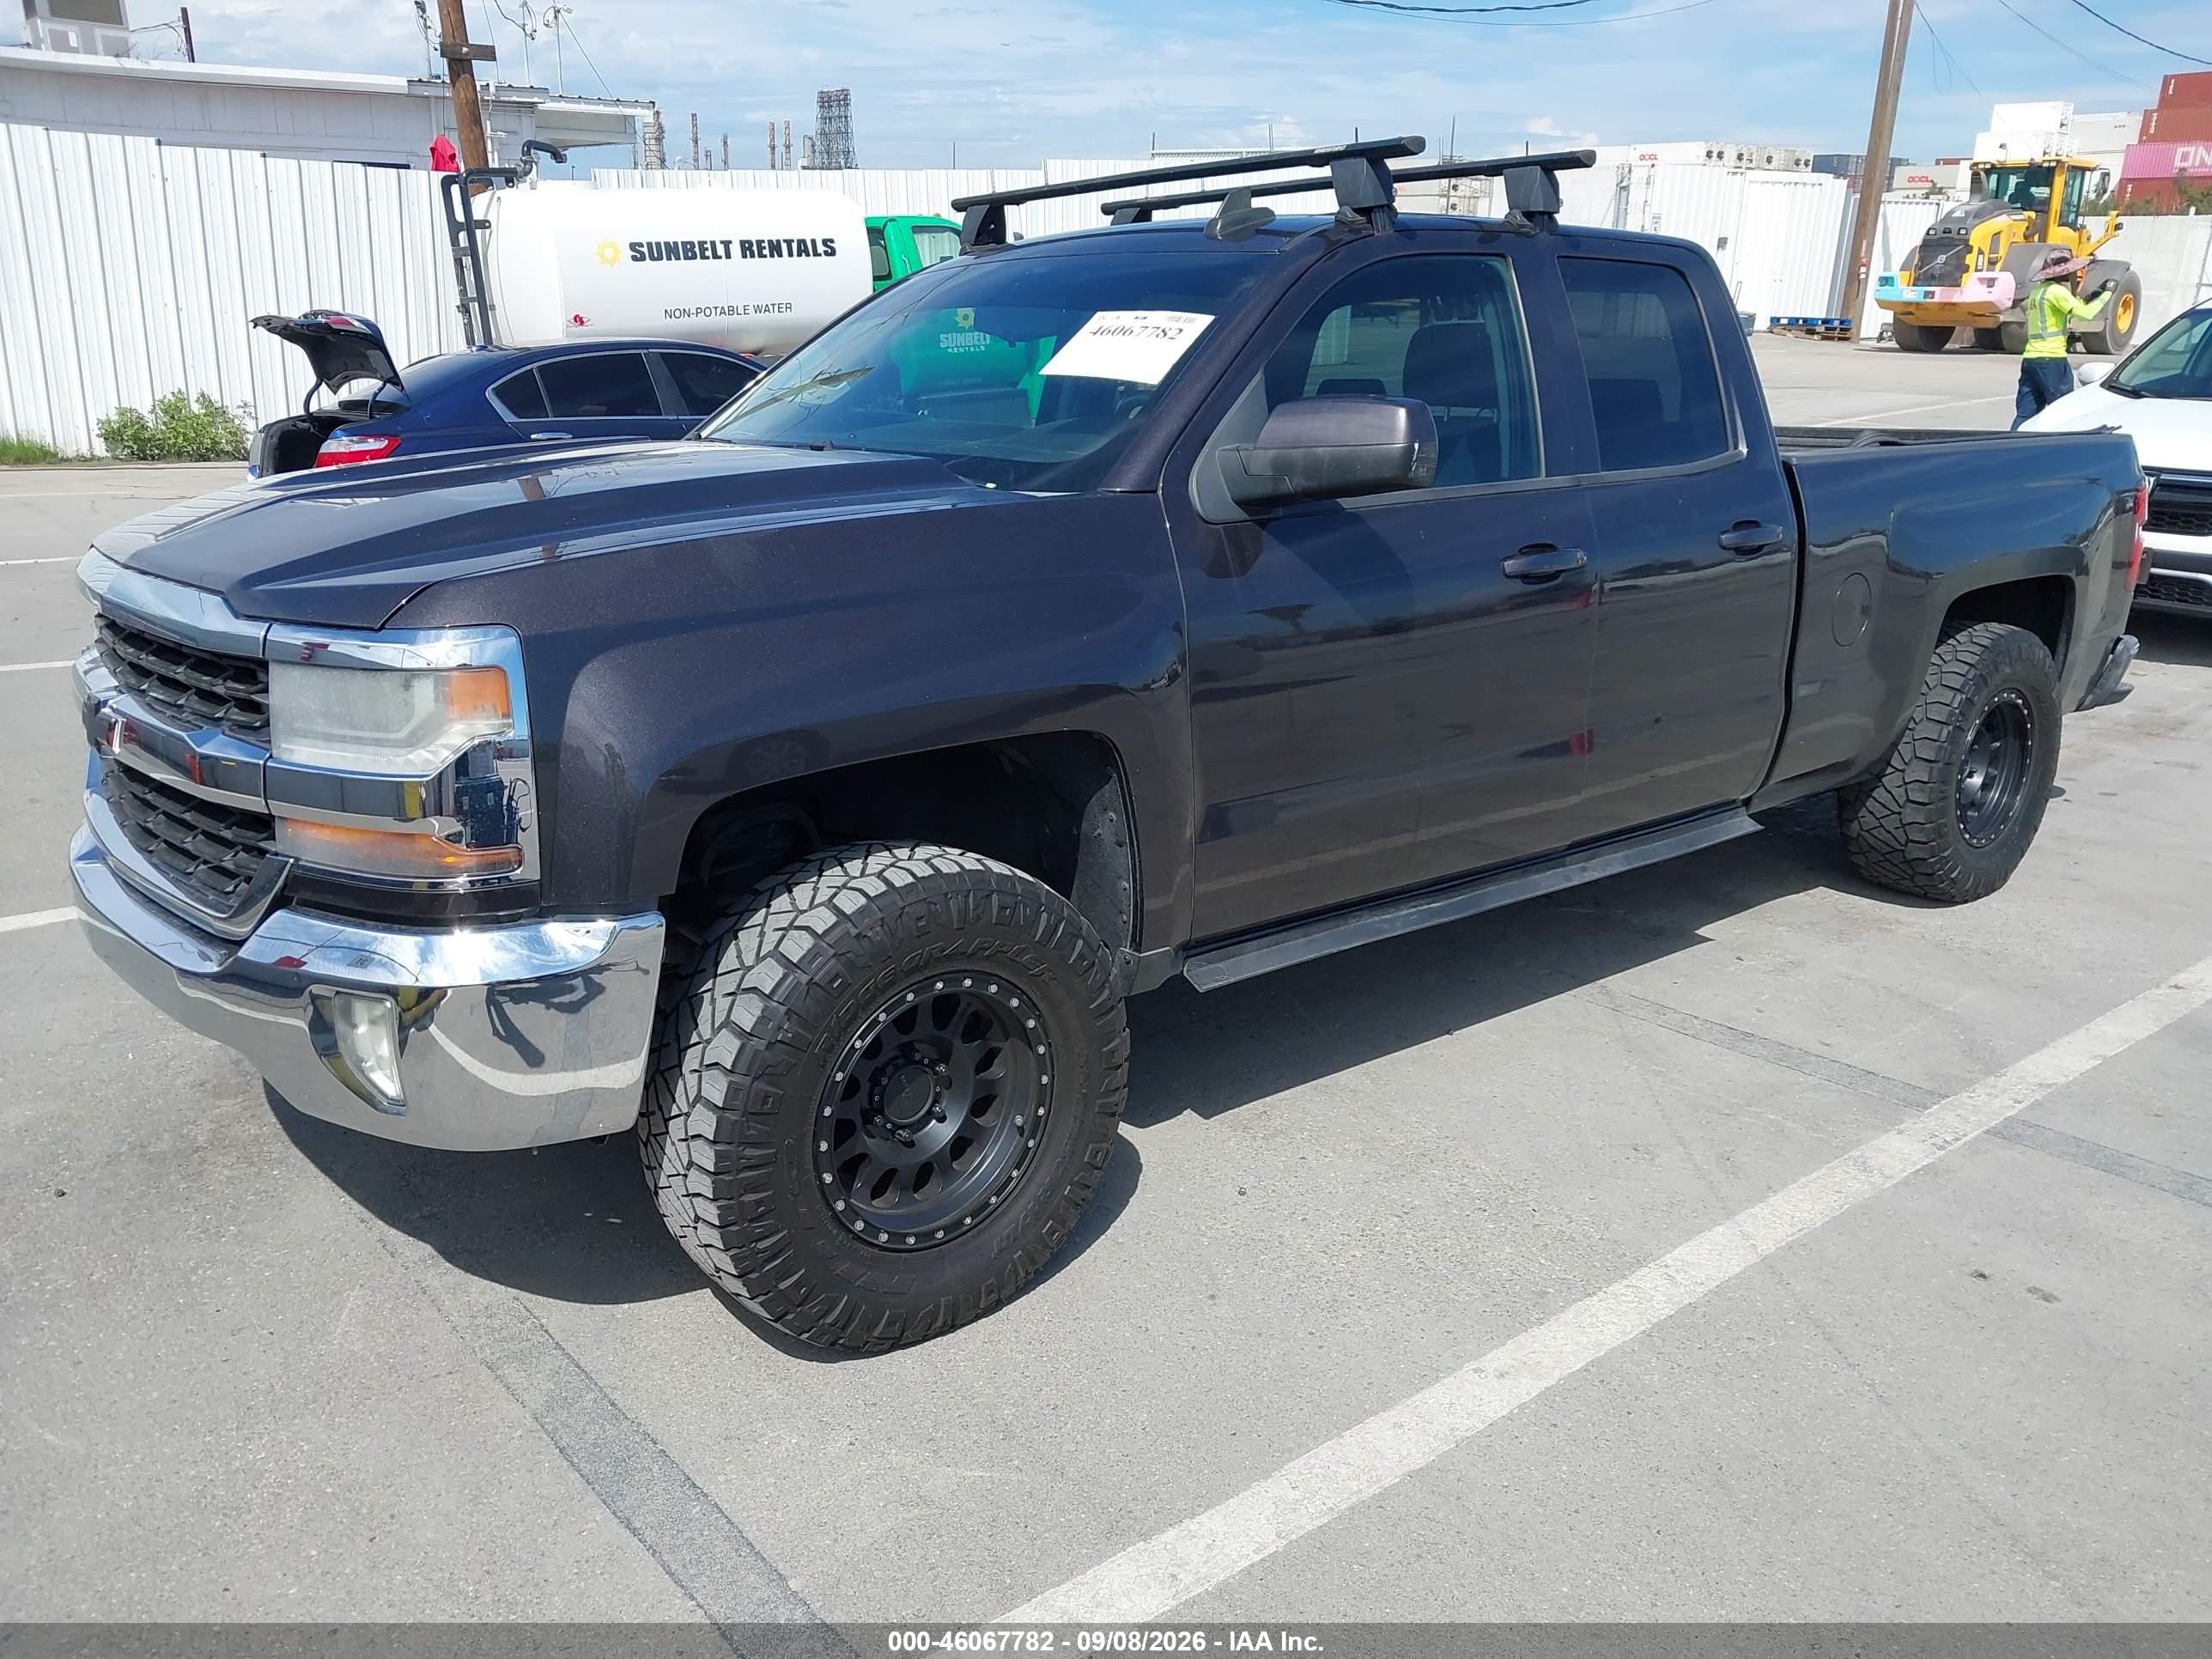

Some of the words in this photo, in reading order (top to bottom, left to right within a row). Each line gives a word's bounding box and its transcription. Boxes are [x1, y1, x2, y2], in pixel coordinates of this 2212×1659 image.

[1907, 175, 1932, 184] OOCL
[629, 240, 732, 262] SUNBELT
[739, 238, 836, 259] RENTALS
[664, 304, 750, 320] NON-POTABLE
[753, 302, 793, 315] WATER
[1090, 325, 1183, 340] 46067782
